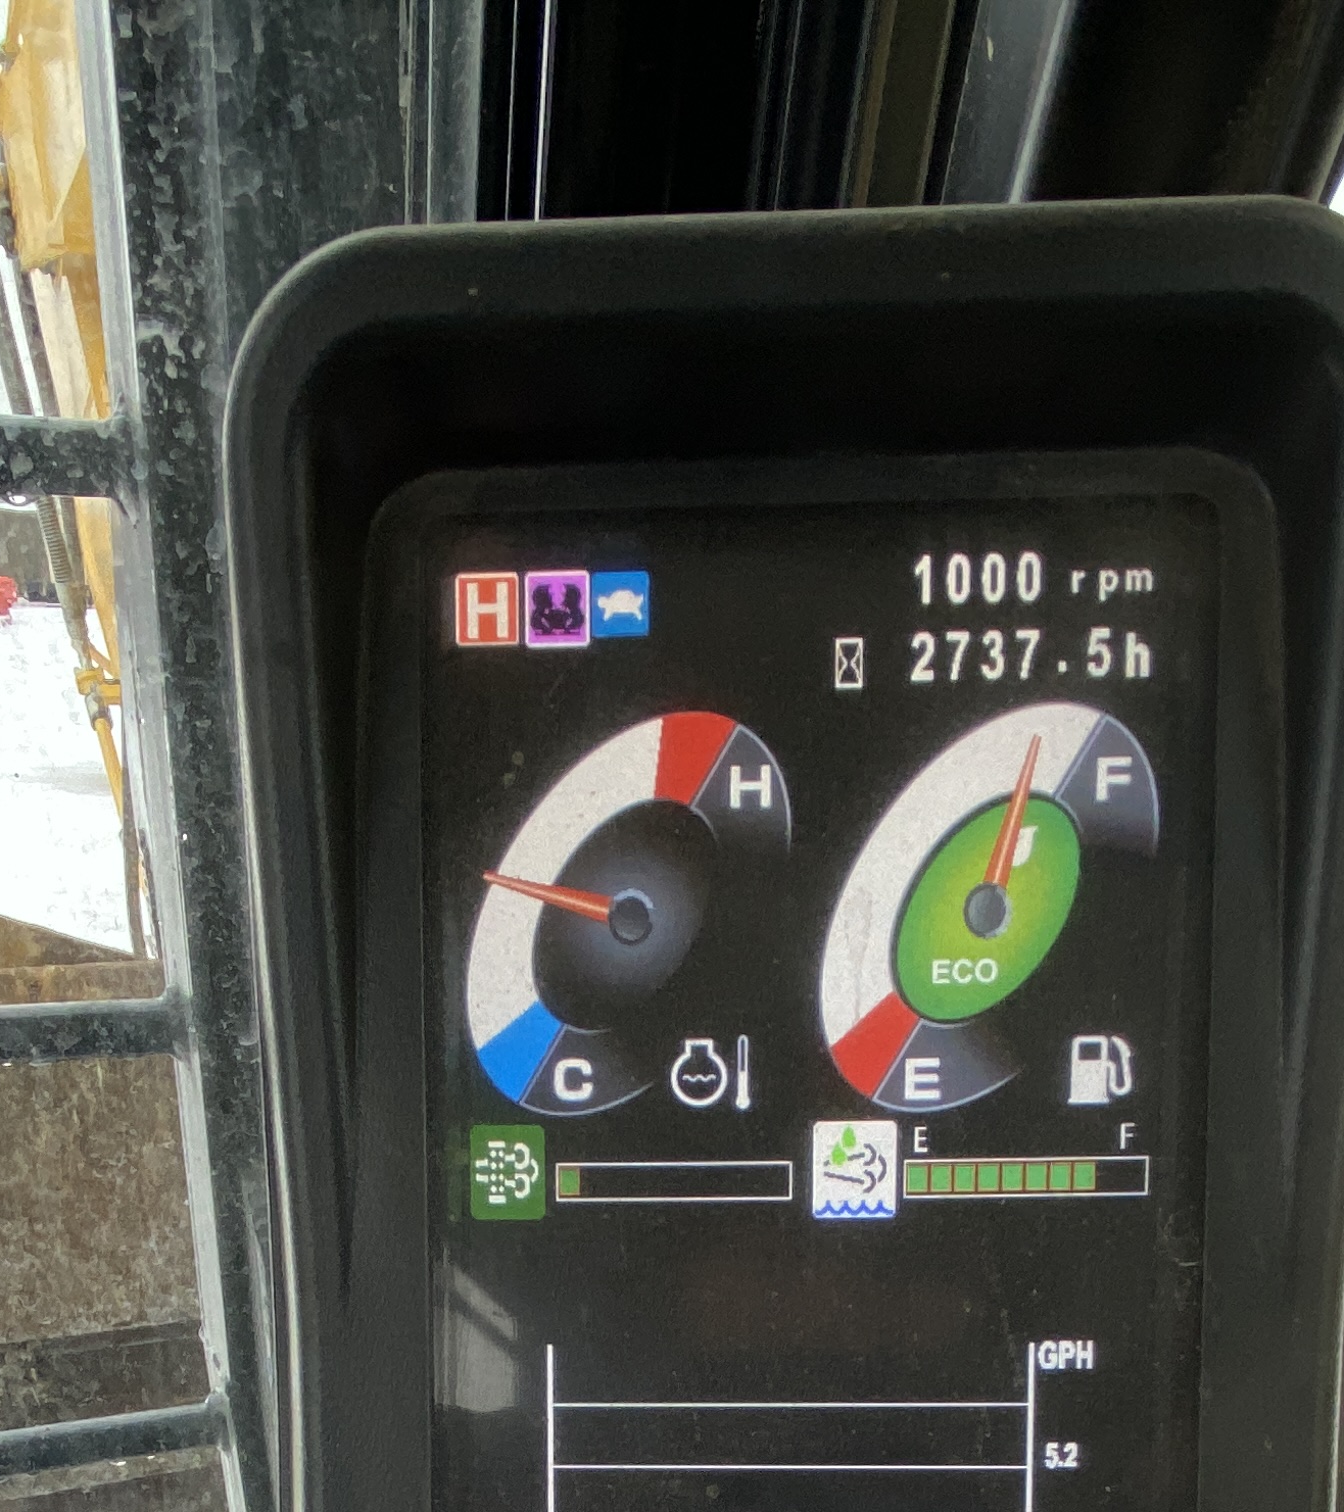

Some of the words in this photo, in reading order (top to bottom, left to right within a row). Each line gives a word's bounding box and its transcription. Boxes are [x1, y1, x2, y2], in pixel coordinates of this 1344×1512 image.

[914, 551, 1042, 606] 1000
[1071, 568, 1154, 602] rpm
[467, 582, 511, 640] H
[728, 764, 773, 809] H
[1095, 756, 1133, 801] F
[931, 957, 999, 985] ECO
[552, 1058, 595, 1103] C
[904, 1058, 941, 1101] E
[913, 1126, 929, 1154] E
[1119, 1122, 1135, 1150] F
[1038, 1341, 1094, 1370] GPH
[1044, 1442, 1078, 1470] 5.2
